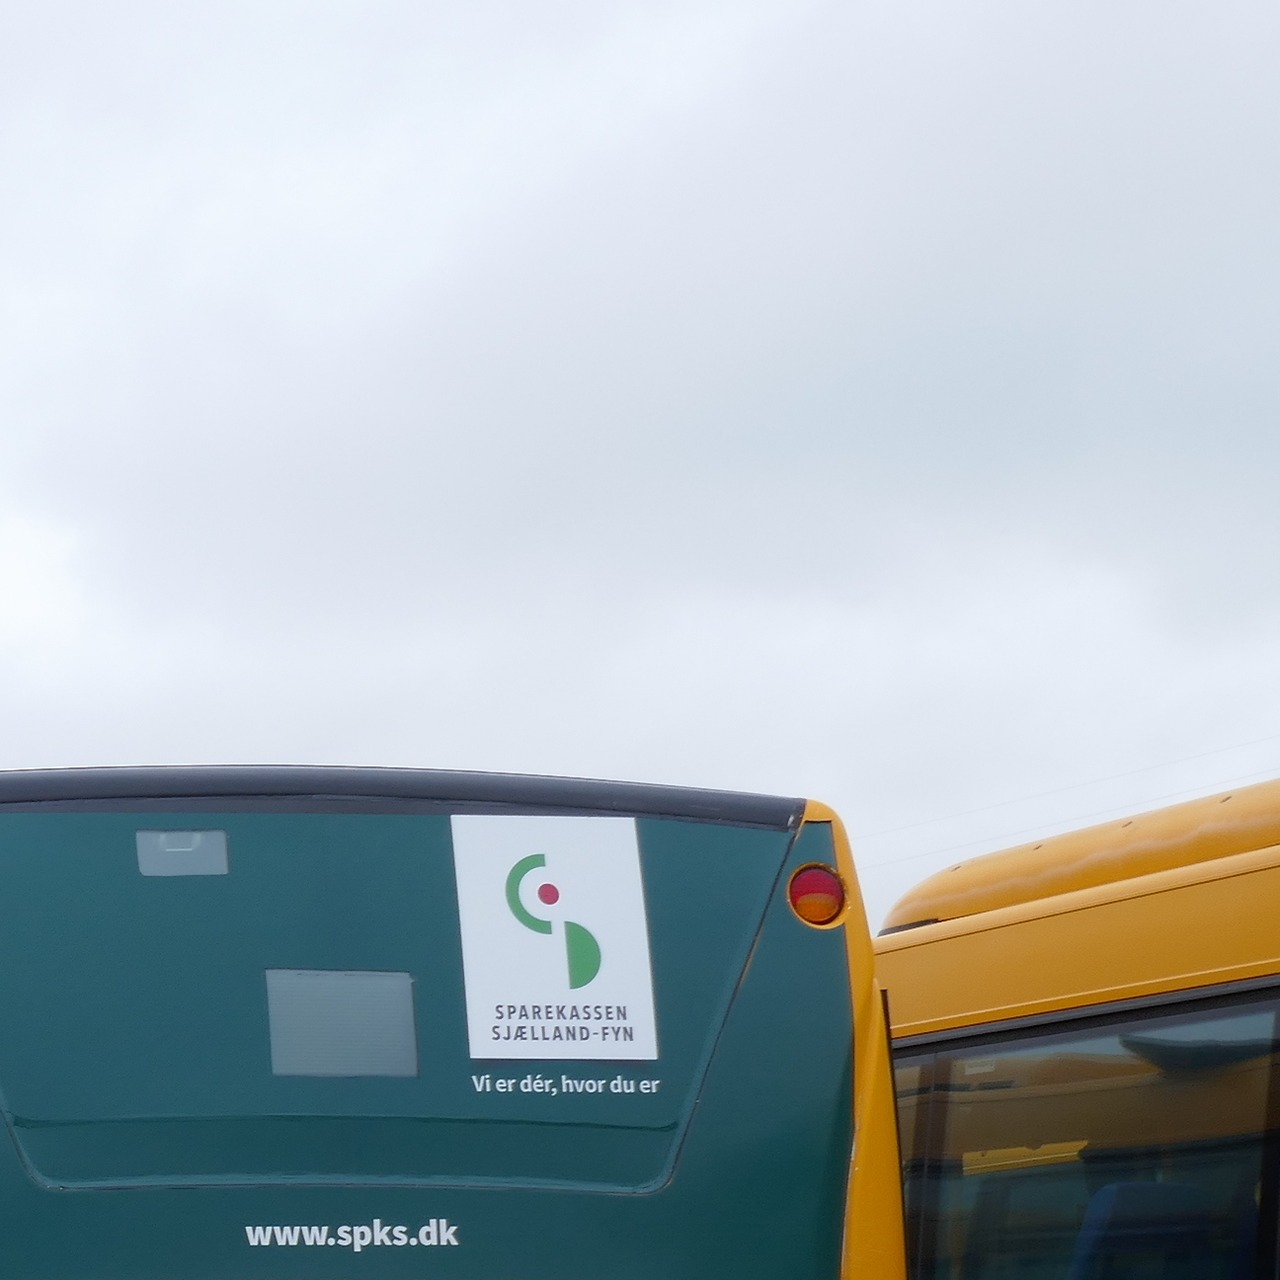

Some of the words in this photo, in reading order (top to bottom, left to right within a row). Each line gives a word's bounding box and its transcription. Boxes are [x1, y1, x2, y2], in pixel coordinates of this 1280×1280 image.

[495, 1004, 628, 1021] SPAREKASSEN
[491, 1025, 634, 1042] SJÆLLAND-FYN
[471, 1075, 491, 1093] Vi
[495, 1079, 517, 1093] er
[519, 1074, 558, 1097] dér,
[561, 1075, 607, 1093] hvor
[610, 1075, 635, 1093] du
[639, 1080, 661, 1093] er
[245, 1219, 459, 1252] www.spks.dk
